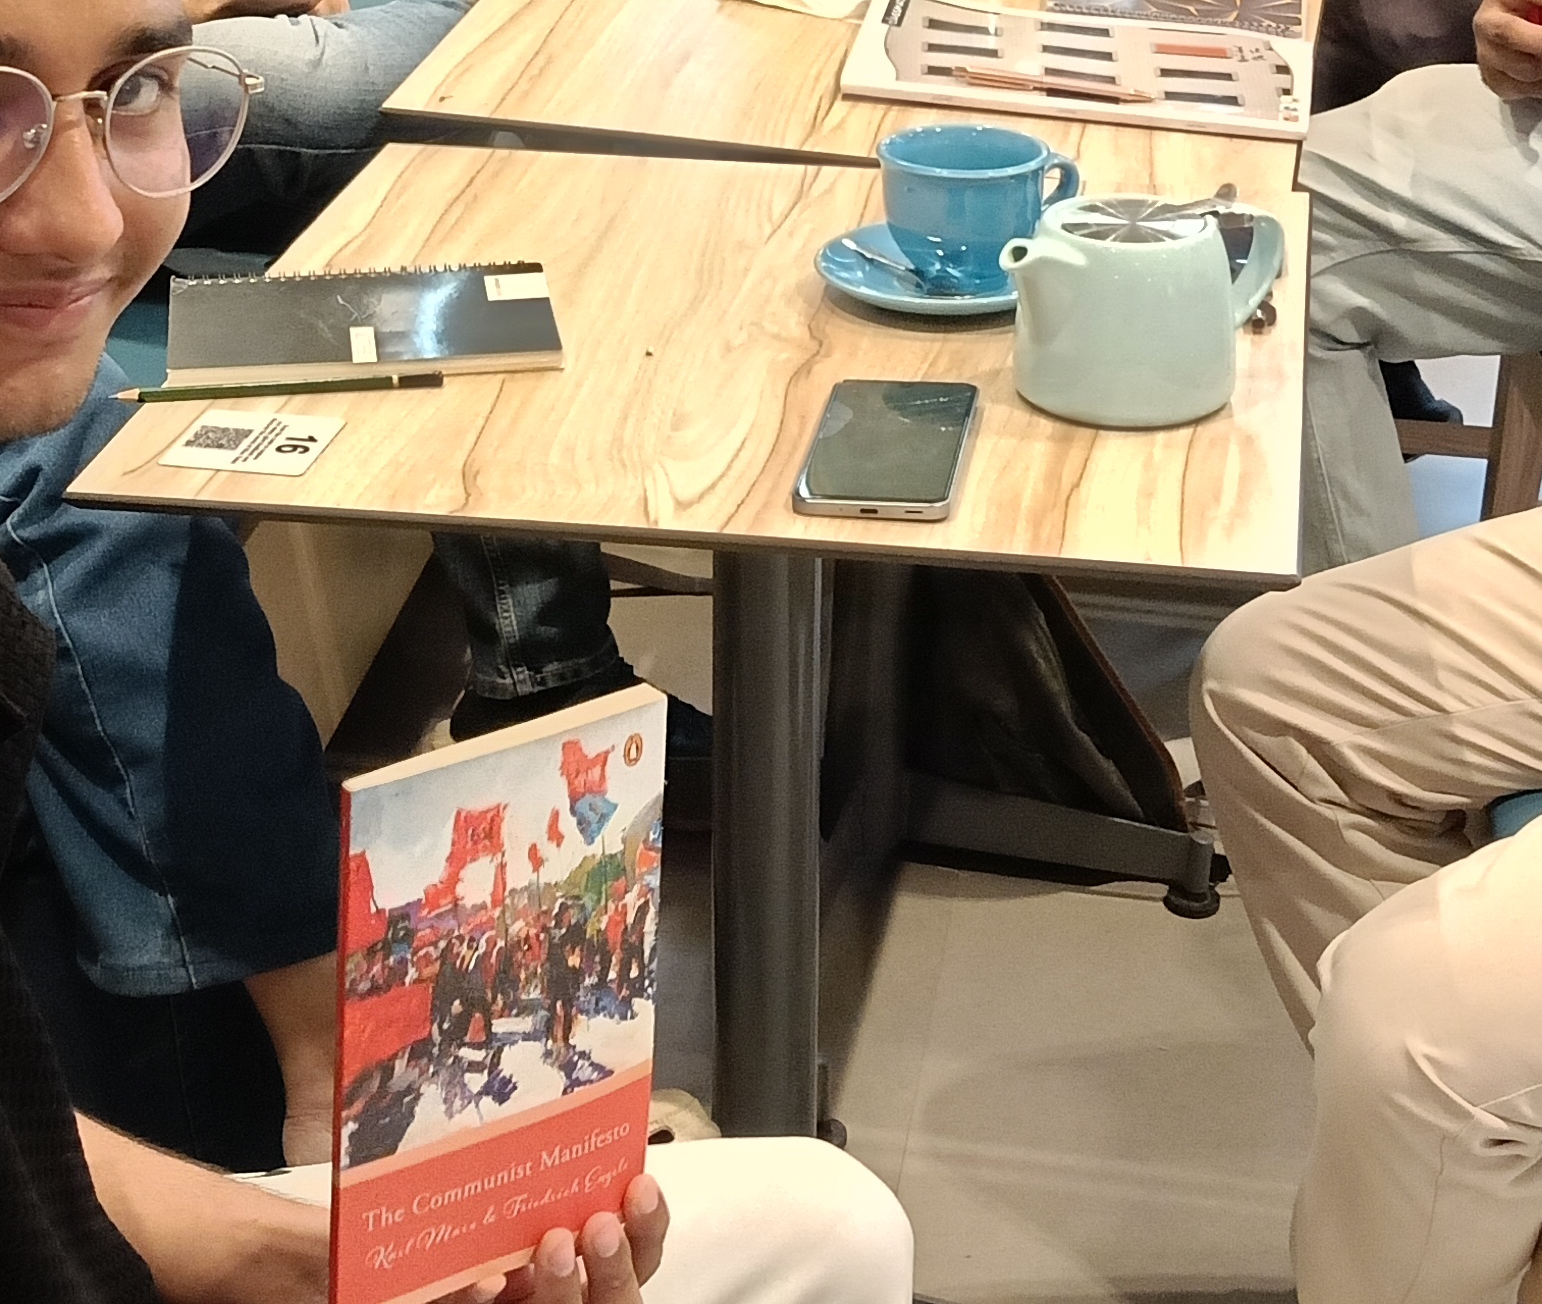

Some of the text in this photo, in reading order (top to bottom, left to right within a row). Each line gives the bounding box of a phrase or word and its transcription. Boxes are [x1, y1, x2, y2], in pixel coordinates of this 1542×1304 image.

[275, 435, 318, 455] 16
[363, 1122, 630, 1233] The Communist Manifesto
[366, 1242, 416, 1271] Karl
[416, 1220, 477, 1252] Marx
[503, 1178, 580, 1220] Friedrich
[583, 1156, 629, 1194] Engels
